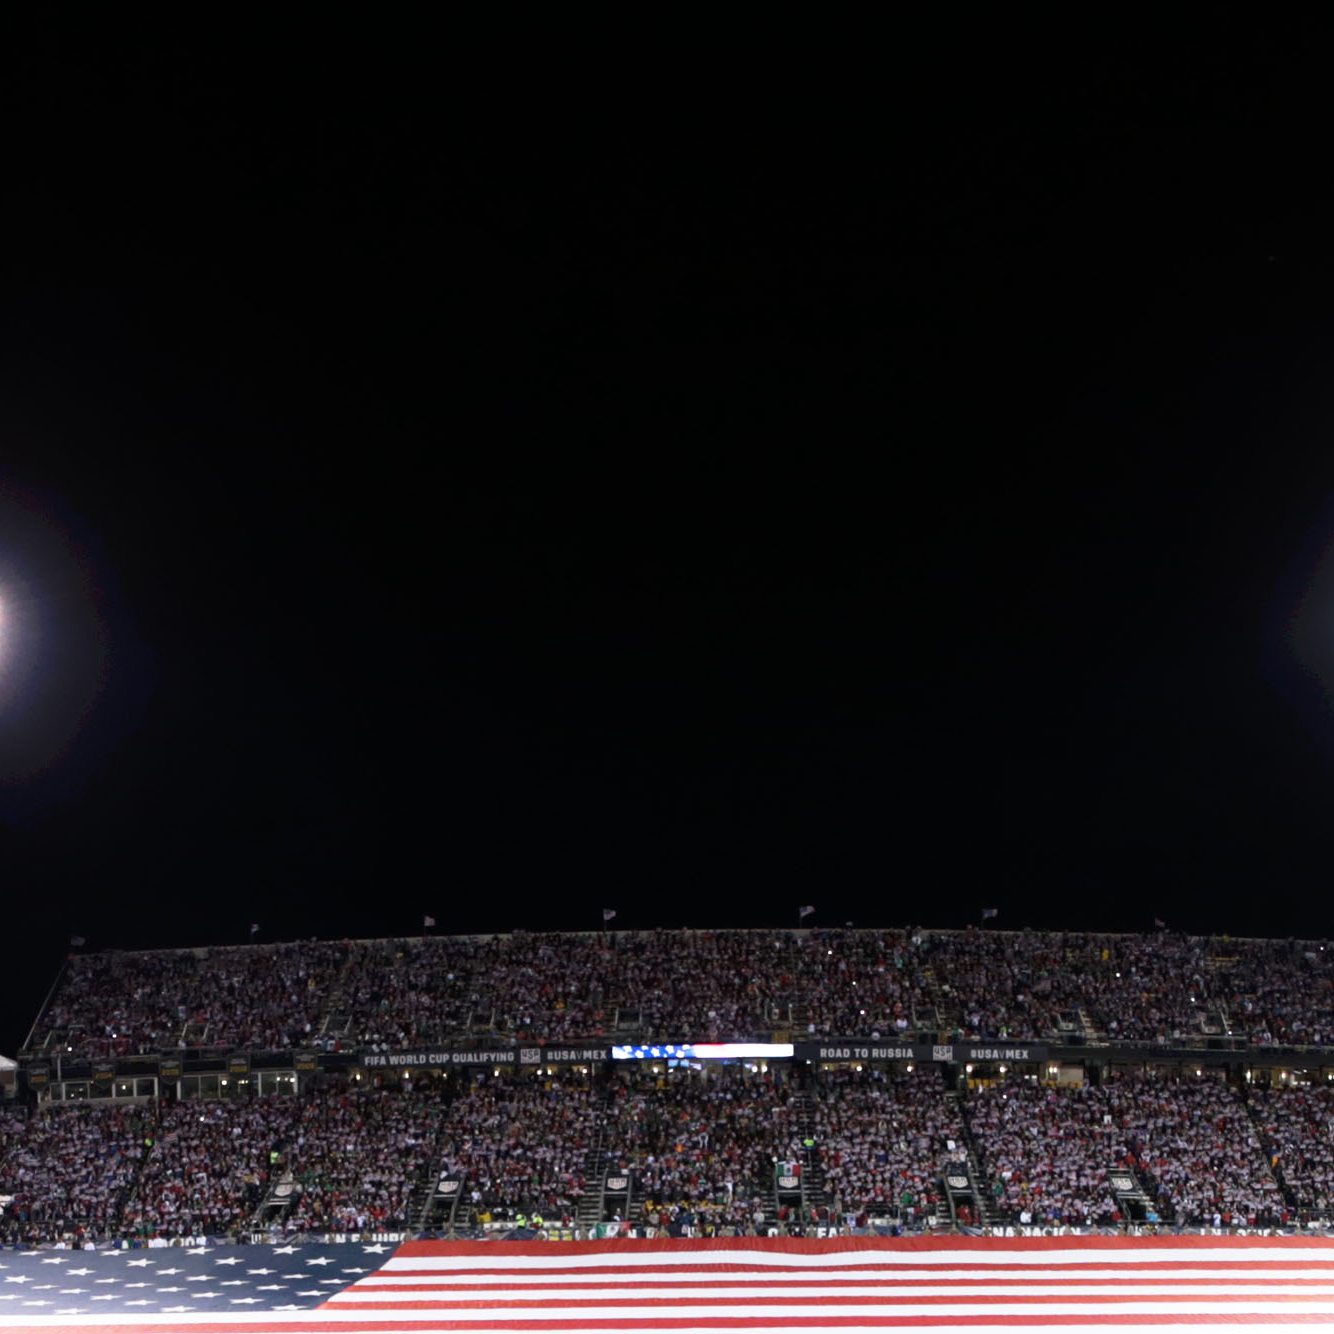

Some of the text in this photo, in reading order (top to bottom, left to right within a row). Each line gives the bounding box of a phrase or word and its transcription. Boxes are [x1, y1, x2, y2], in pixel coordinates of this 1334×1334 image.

[365, 1052, 515, 1066] FIFA WORLD CUP QUALIFYING
[820, 1048, 914, 1058] ROAD TO RUSSIA
